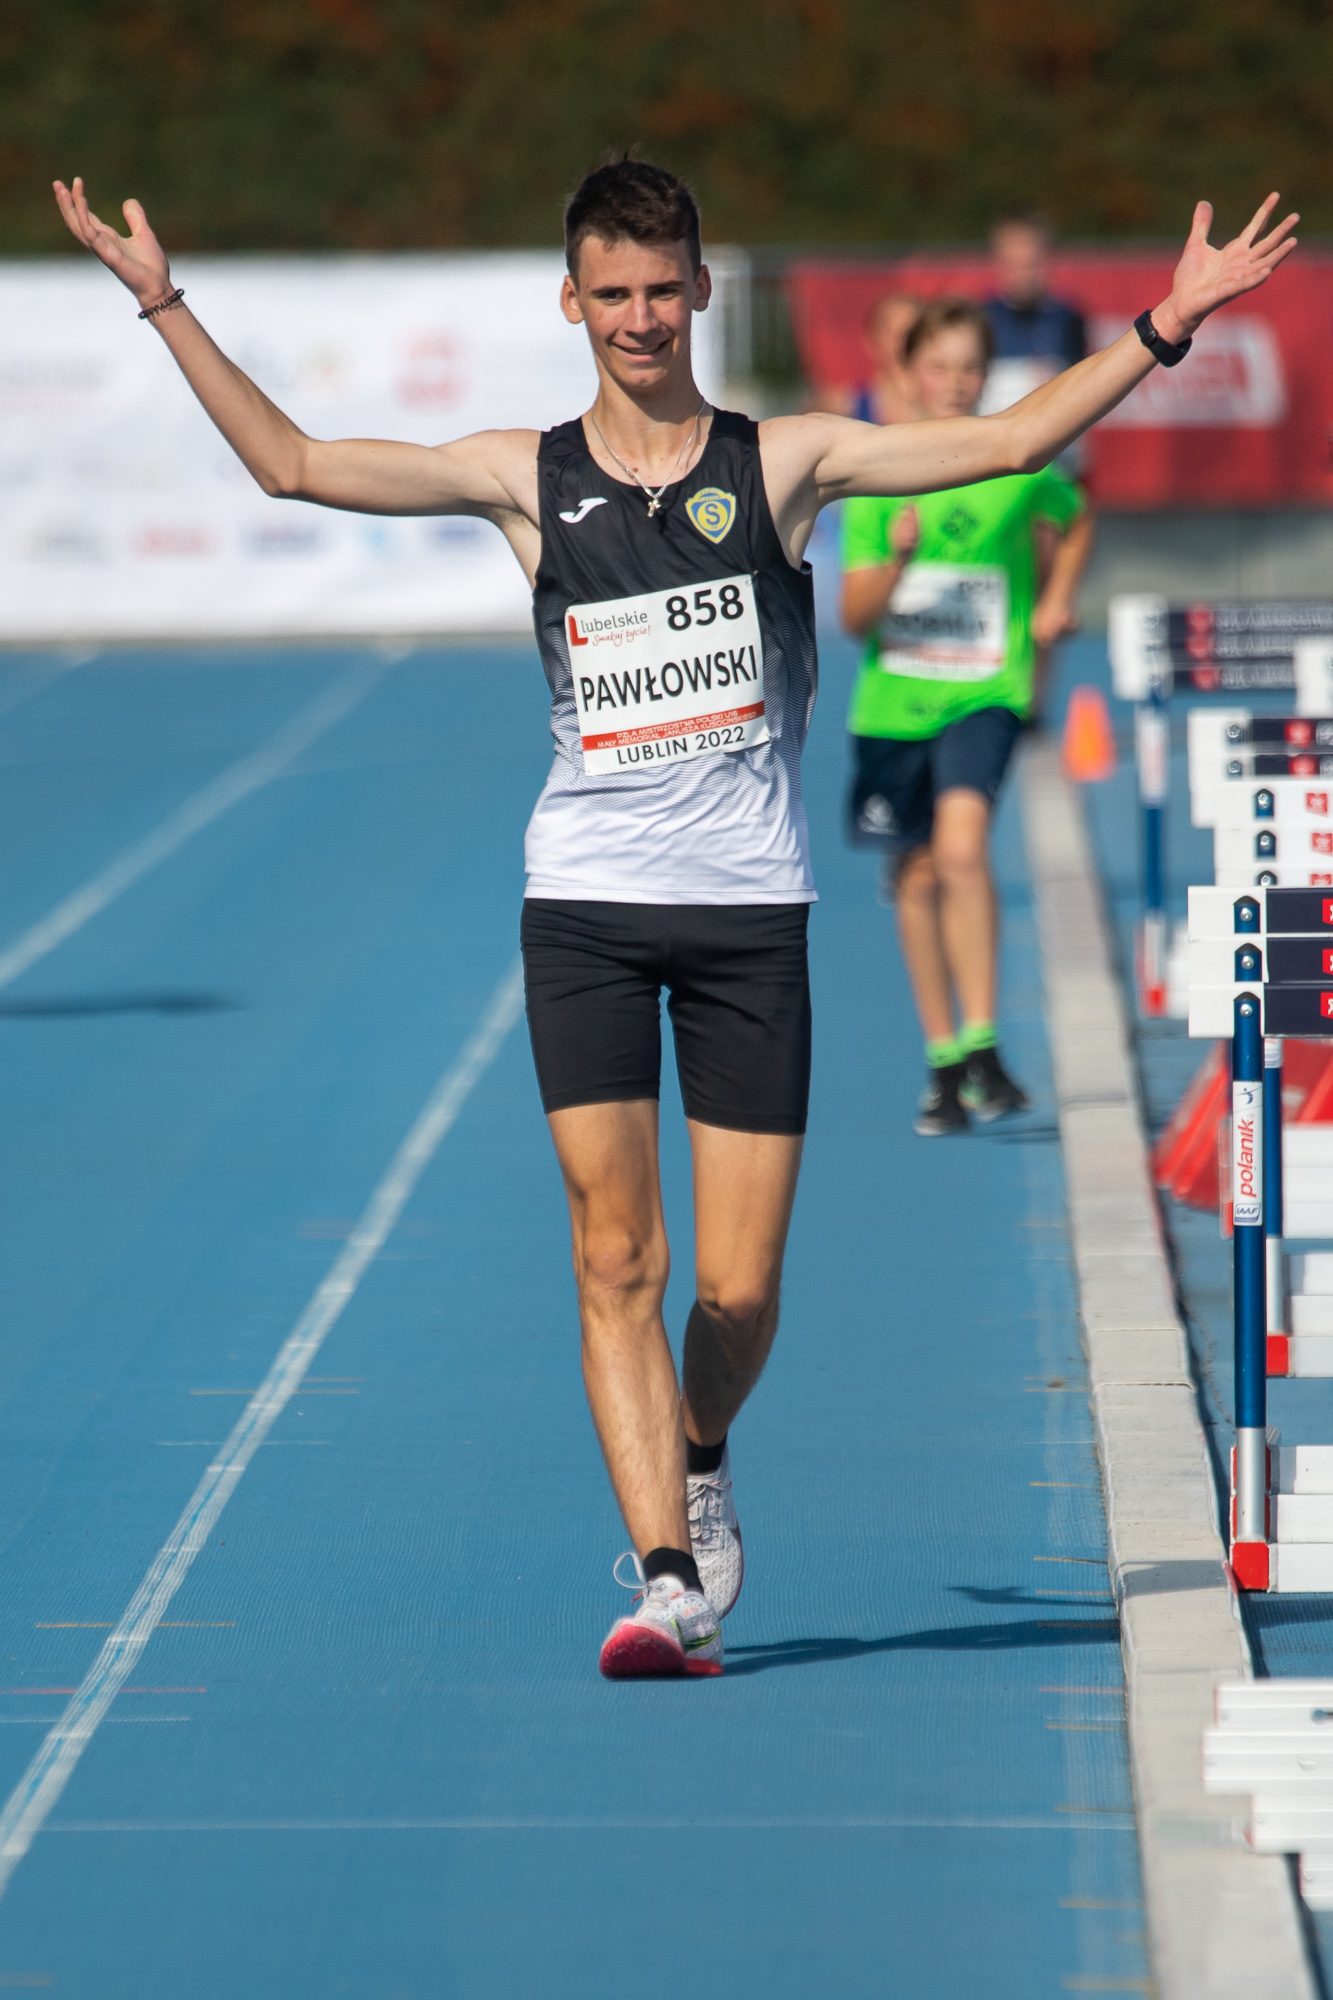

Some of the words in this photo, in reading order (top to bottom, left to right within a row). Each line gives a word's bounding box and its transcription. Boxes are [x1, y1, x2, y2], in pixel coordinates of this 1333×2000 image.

[704, 503, 721, 526] S
[665, 584, 744, 632] 858
[579, 645, 758, 713] PAWŁOWSKI
[616, 731, 637, 739] PZLA
[639, 720, 695, 736] MISTRZOSTWA
[696, 713, 723, 725] POLSKI
[618, 732, 661, 745] MEMORIAŁ
[662, 724, 699, 738] JANUSZA
[616, 737, 688, 765] LUBLIN
[695, 725, 746, 751] 2022
[1237, 1118, 1257, 1198] polanik
[1236, 1207, 1259, 1215] IAAF
